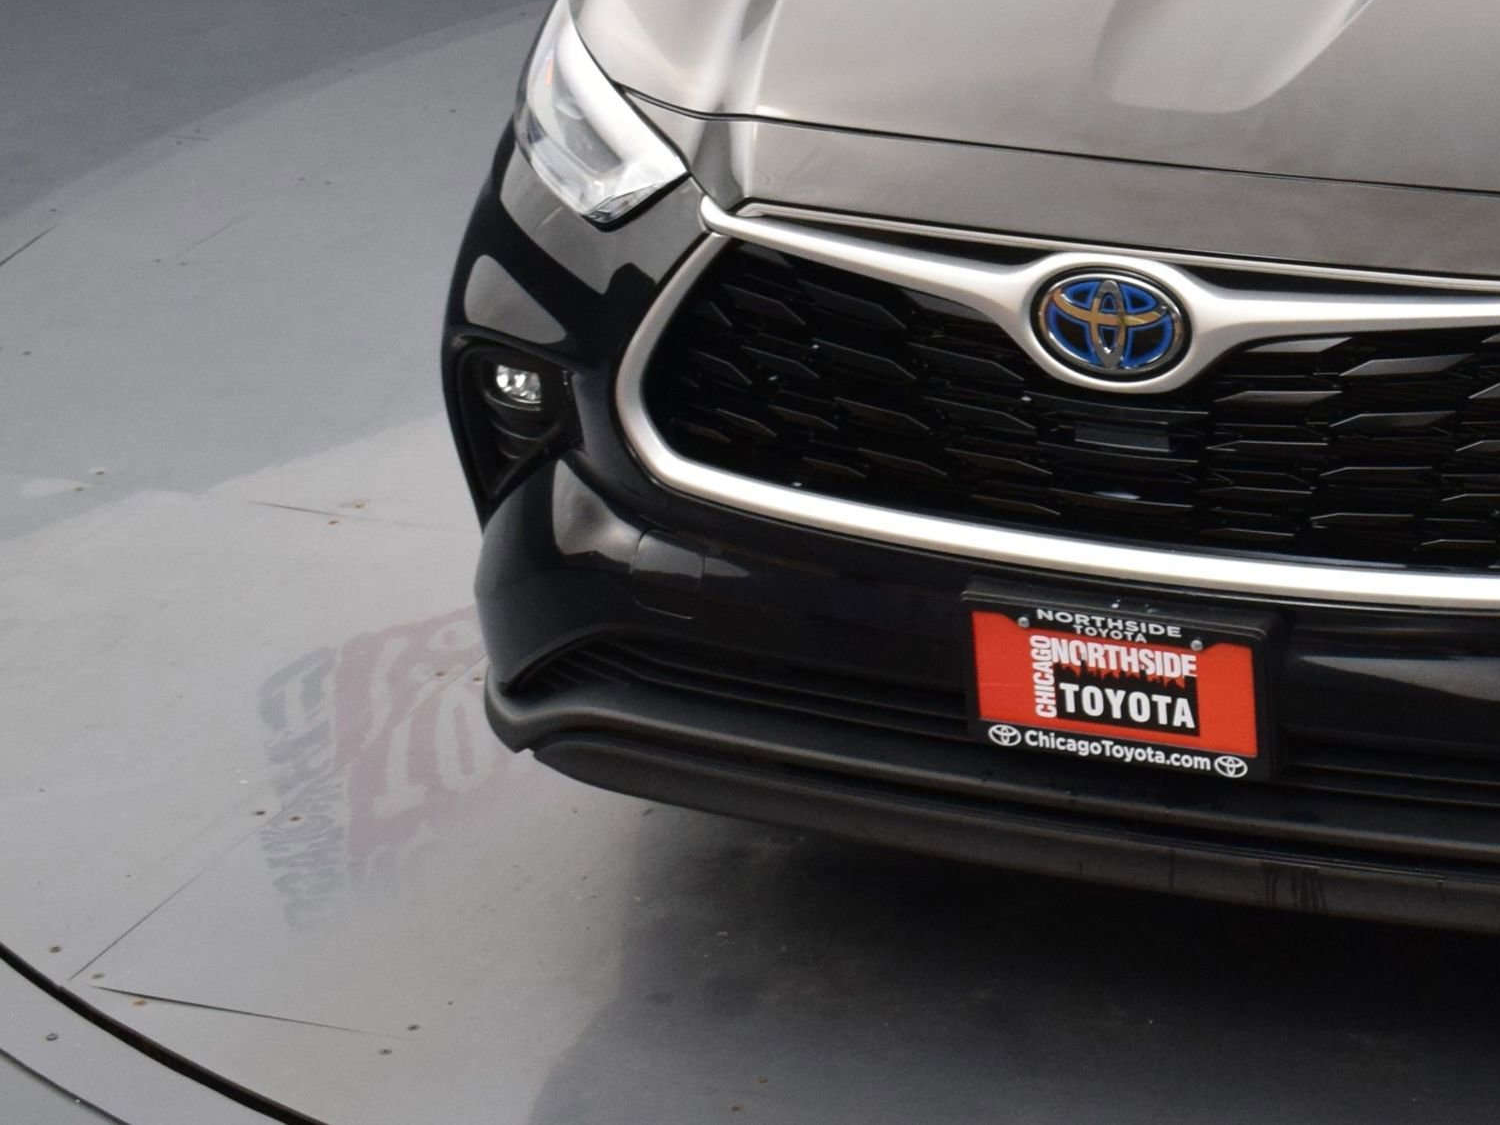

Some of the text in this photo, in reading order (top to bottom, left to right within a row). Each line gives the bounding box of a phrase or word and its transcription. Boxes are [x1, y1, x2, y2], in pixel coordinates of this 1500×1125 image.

[1036, 608, 1182, 638] NORTHSIDE
[1074, 625, 1147, 643] TOYOTA
[1030, 635, 1057, 718] CHICAGO
[1052, 637, 1198, 678] NORTHSIDE
[1060, 682, 1195, 728] TOYOTA
[1024, 730, 1211, 771] ChicagoToyota.com
